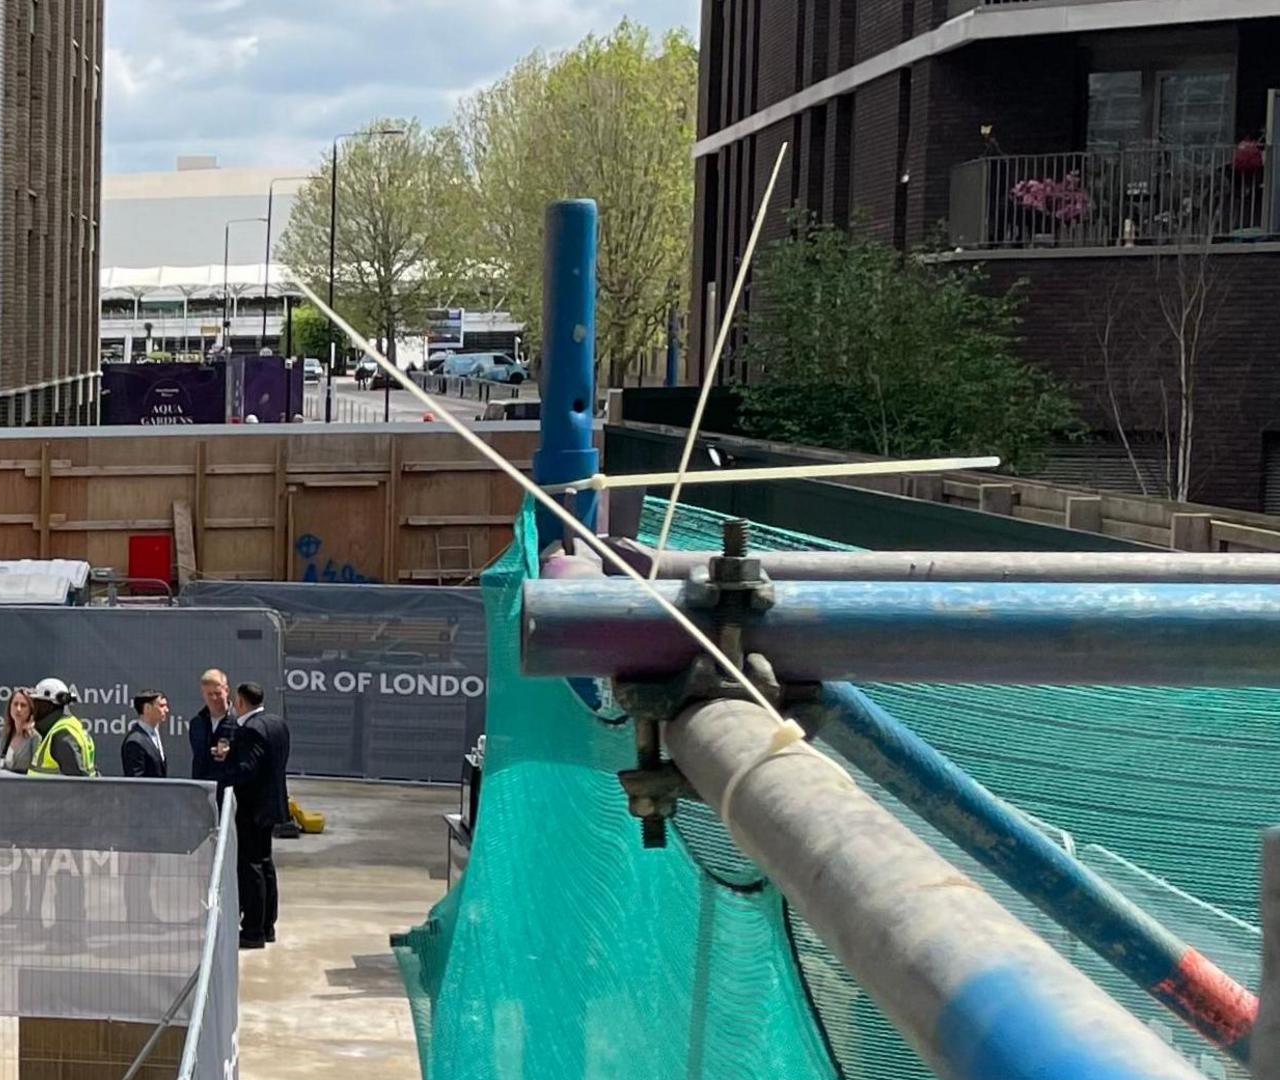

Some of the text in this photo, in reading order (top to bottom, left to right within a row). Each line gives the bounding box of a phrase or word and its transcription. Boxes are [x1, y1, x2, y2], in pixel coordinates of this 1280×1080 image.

[151, 404, 183, 414] AQUA
[141, 416, 194, 426] GARDENS
[285, 669, 486, 697] OR OF LONDO
